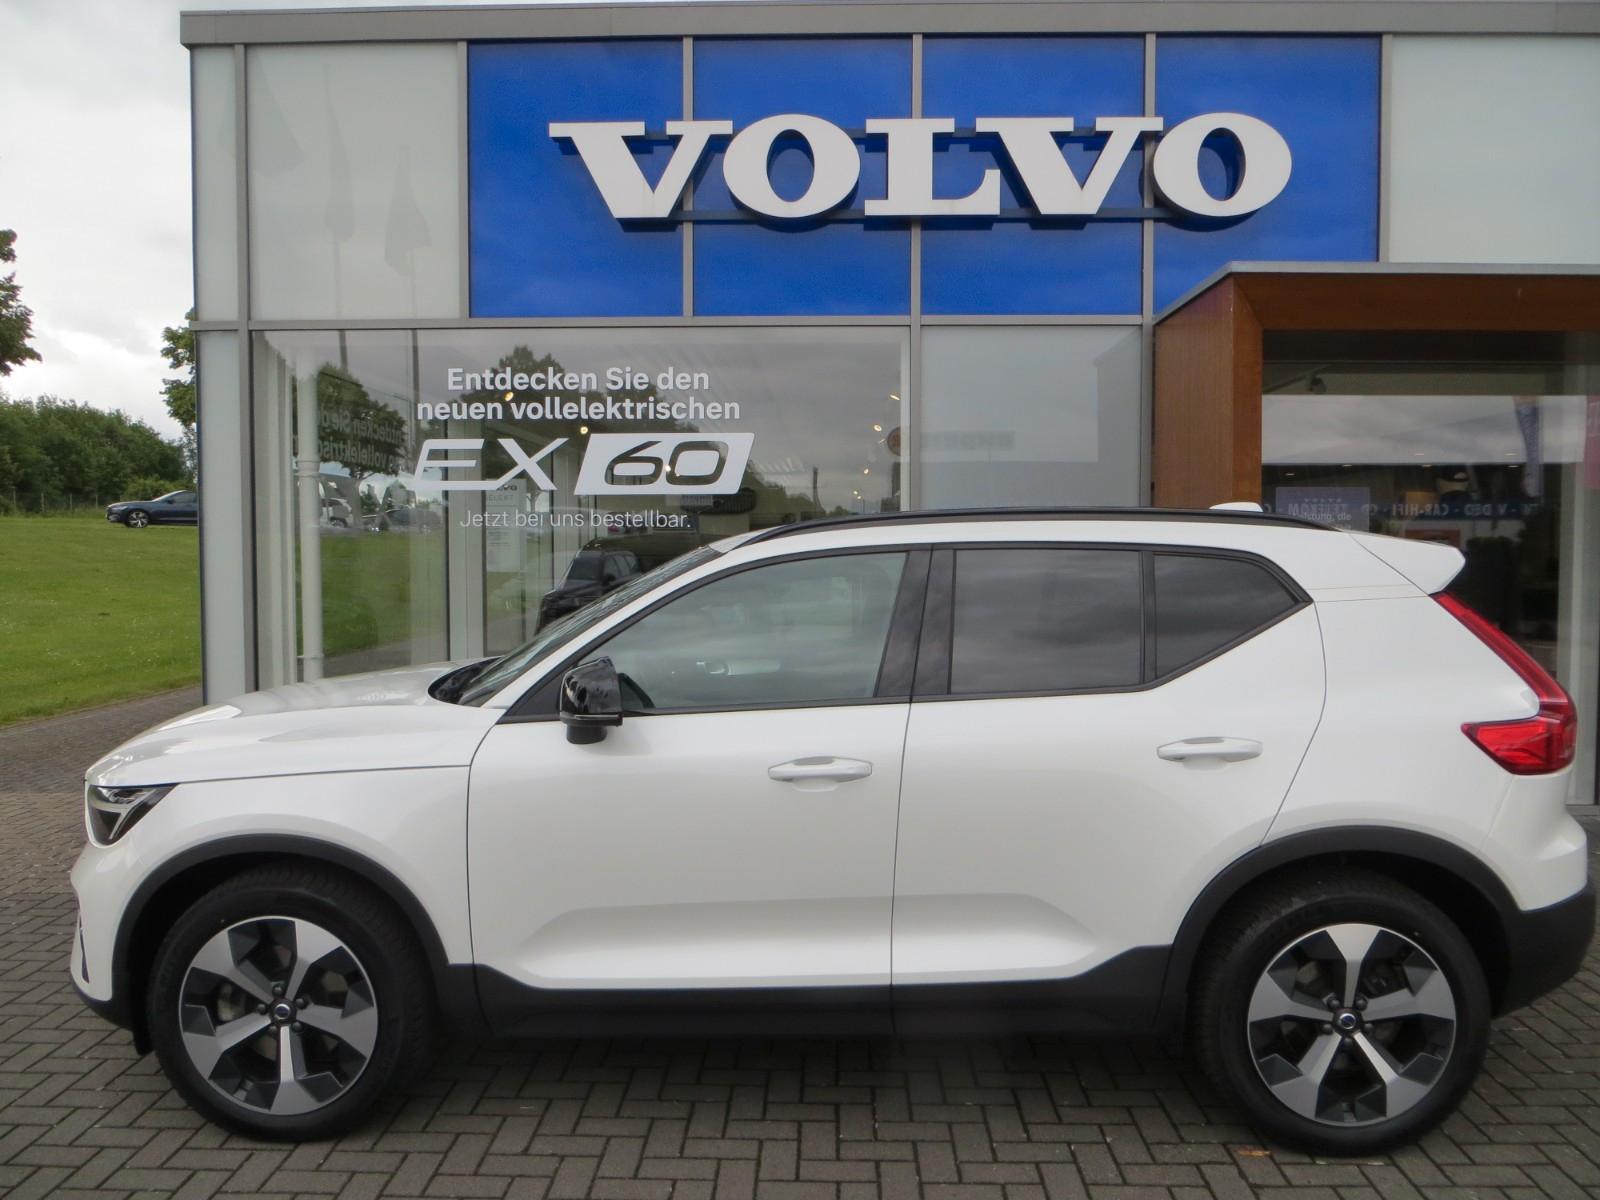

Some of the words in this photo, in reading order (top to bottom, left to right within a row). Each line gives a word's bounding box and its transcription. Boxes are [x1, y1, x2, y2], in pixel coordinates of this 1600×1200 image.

[548, 112, 1292, 219] VOLVO
[447, 366, 598, 391] Entdecken
[605, 366, 650, 391] Sie
[656, 366, 710, 391] den
[416, 399, 503, 421] neuen
[509, 396, 741, 421] vollelektrischen
[459, 510, 510, 529] Jetzt
[515, 510, 544, 529] bei
[550, 514, 585, 529] uns
[591, 510, 691, 529] bestellbar.
